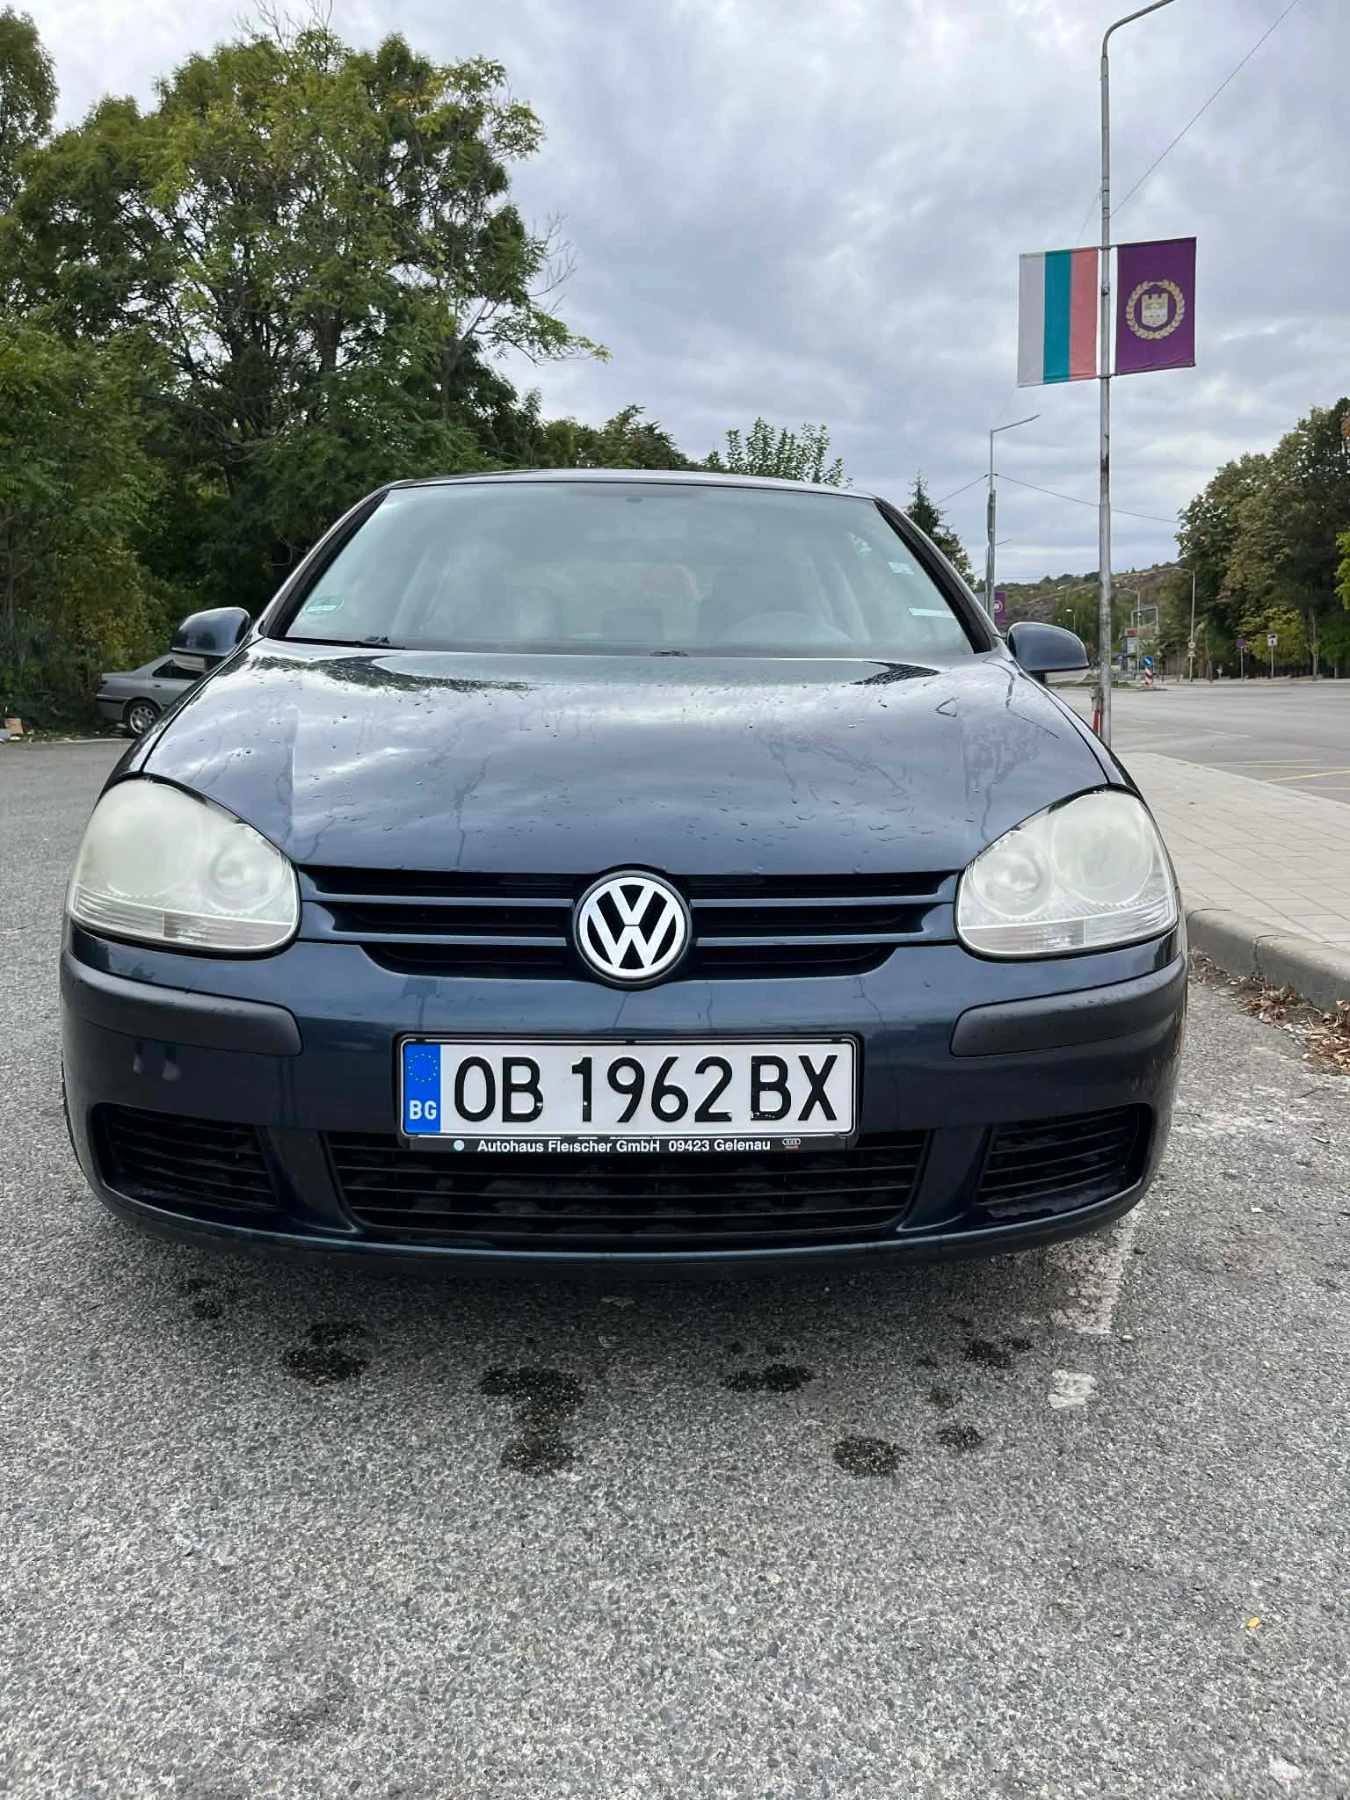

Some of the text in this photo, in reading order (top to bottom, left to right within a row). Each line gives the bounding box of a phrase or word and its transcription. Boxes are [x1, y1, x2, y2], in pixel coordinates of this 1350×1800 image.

[580, 878, 684, 977] VW
[409, 1100, 437, 1120] BG
[454, 1055, 838, 1123] OB 1962 BX
[477, 1139, 544, 1152] Autohaus
[616, 1139, 660, 1152] GmbH
[668, 1139, 710, 1152] 09423
[714, 1138, 771, 1151] Gelenau
